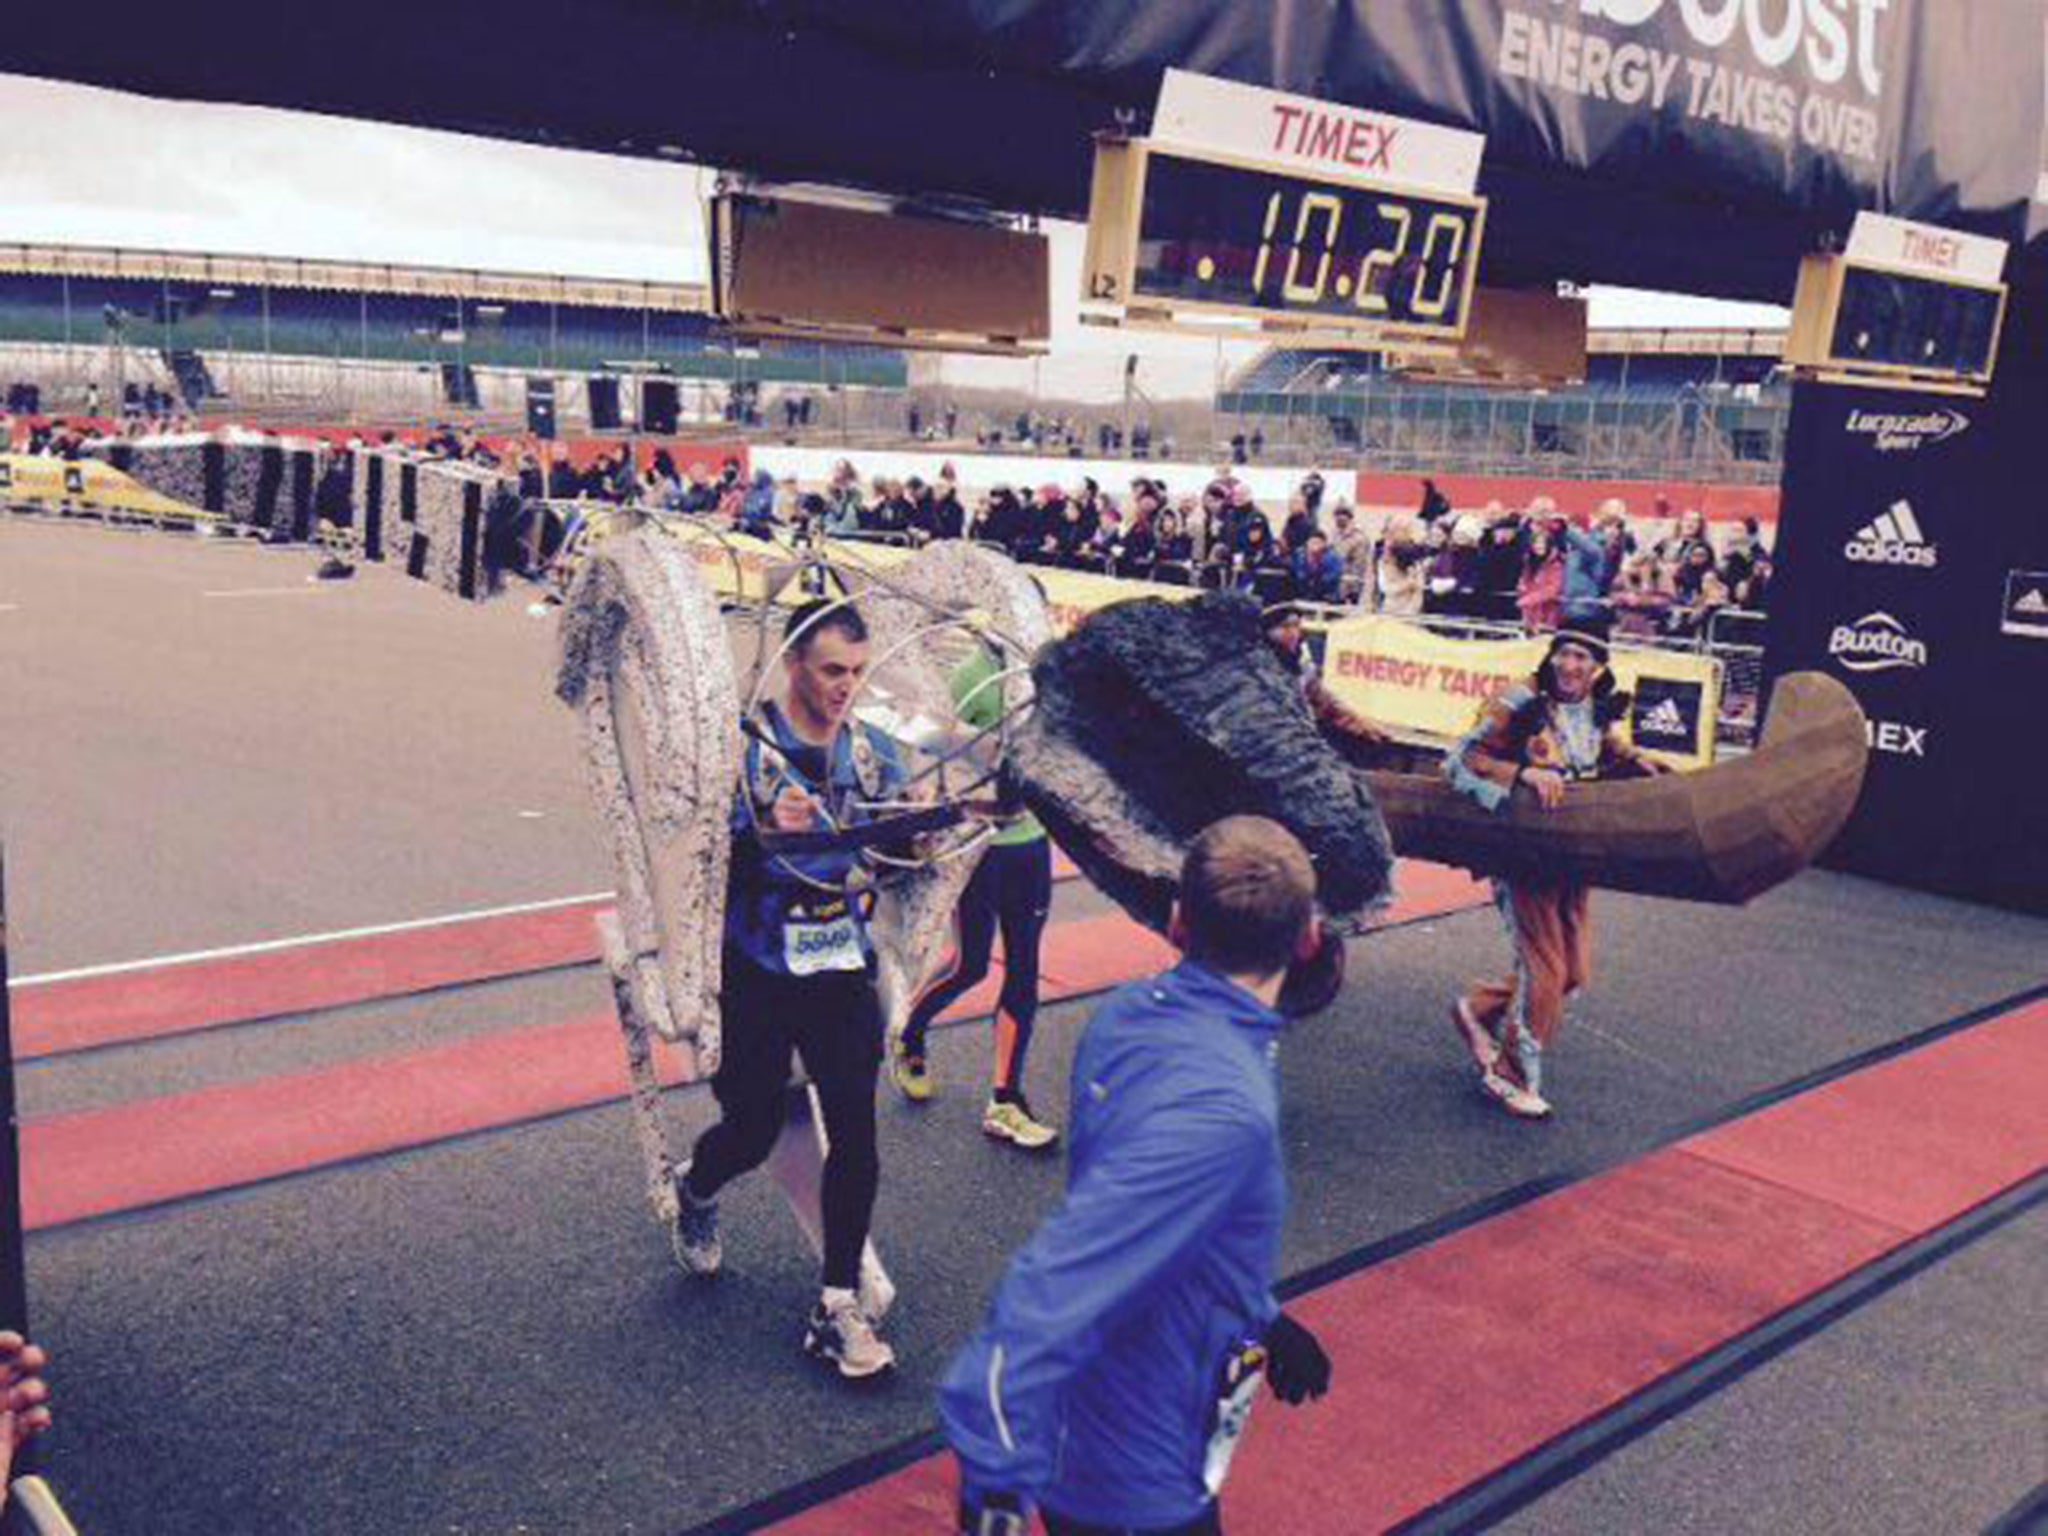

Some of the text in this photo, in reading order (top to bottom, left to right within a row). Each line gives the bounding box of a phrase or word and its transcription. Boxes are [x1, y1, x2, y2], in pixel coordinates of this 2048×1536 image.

[1580, 0, 1889, 96] oost
[1500, 11, 1881, 161] ENERGY TAKES OVER
[1274, 104, 1399, 170] TIMEX
[1845, 536, 1938, 568] adidas
[1828, 625, 1927, 666] Buxton
[1336, 651, 1433, 690] ENERGY
[1865, 719, 1928, 757] EX
